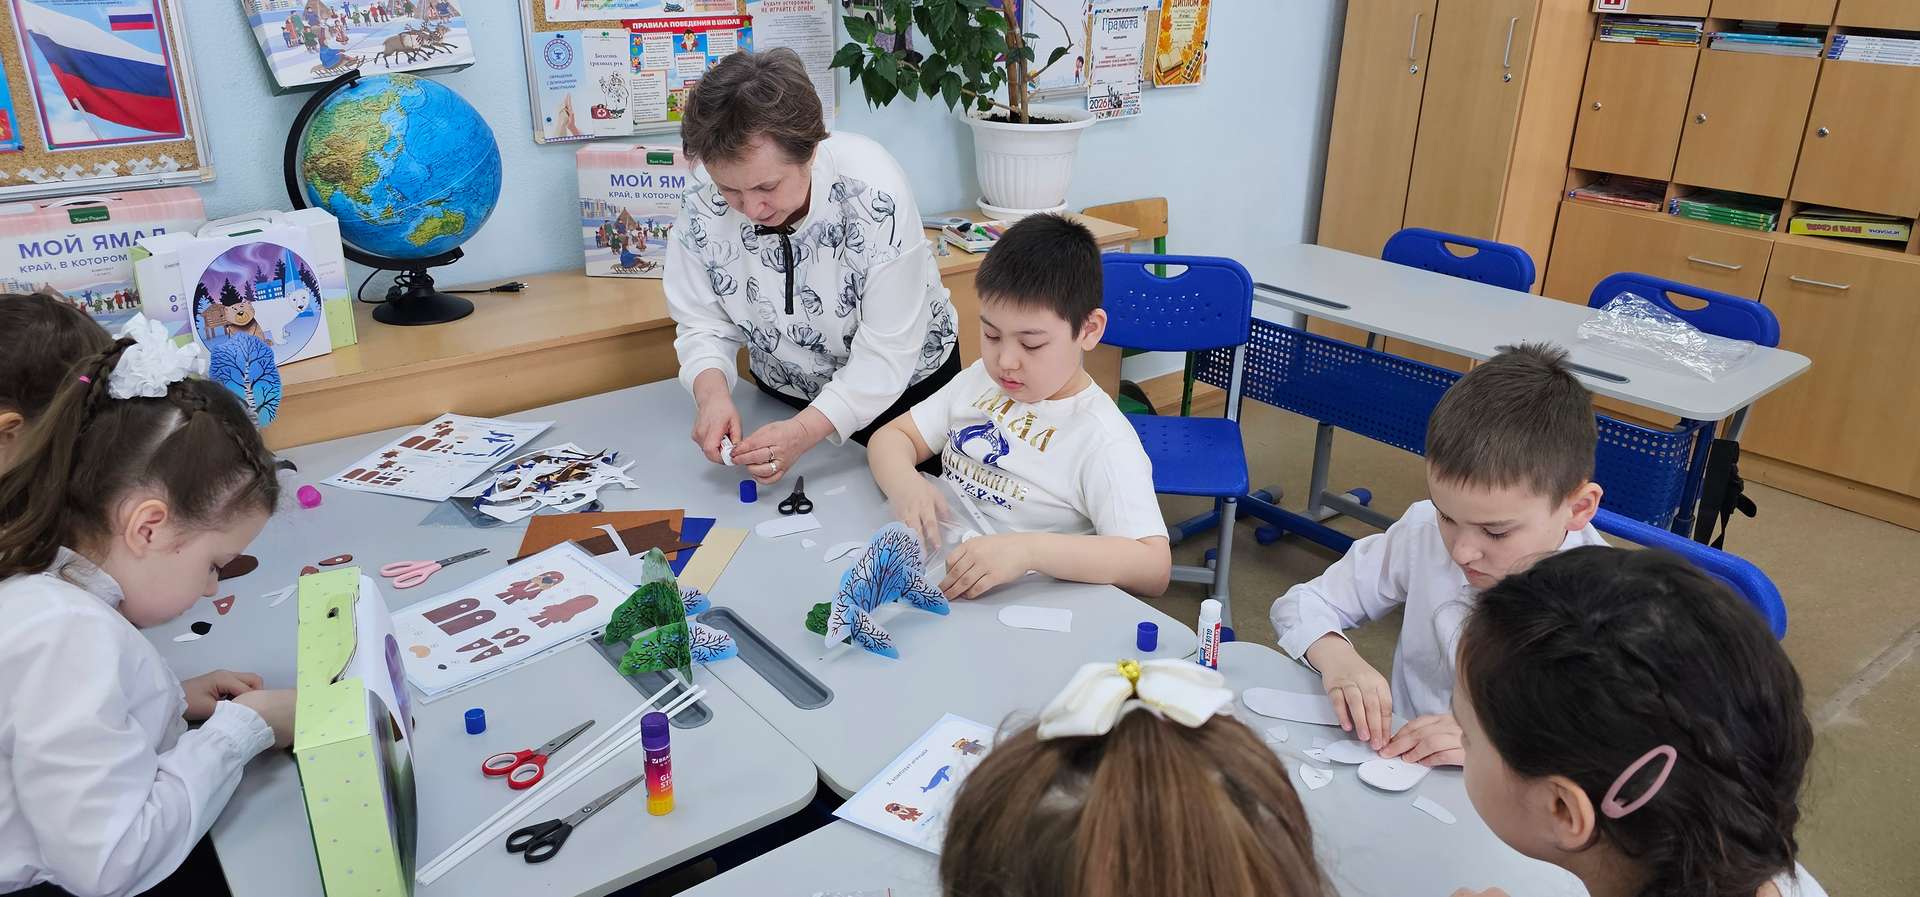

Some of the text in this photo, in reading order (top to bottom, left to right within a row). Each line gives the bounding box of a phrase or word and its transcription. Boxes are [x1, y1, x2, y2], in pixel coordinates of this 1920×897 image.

[632, 21, 670, 29] ПРАВИЛА
[671, 20, 711, 28] ПОВЕДЕНИЯ
[717, 18, 741, 26] ШКОЛЕ
[1102, 16, 1139, 34] Грамота
[1090, 99, 1108, 109] 2026
[610, 172, 653, 188] МОЙ
[609, 191, 633, 199] КРАЙ,
[18, 234, 84, 259] МОЙ
[20, 254, 128, 274] КРАЙ, В КОТОРОМ
